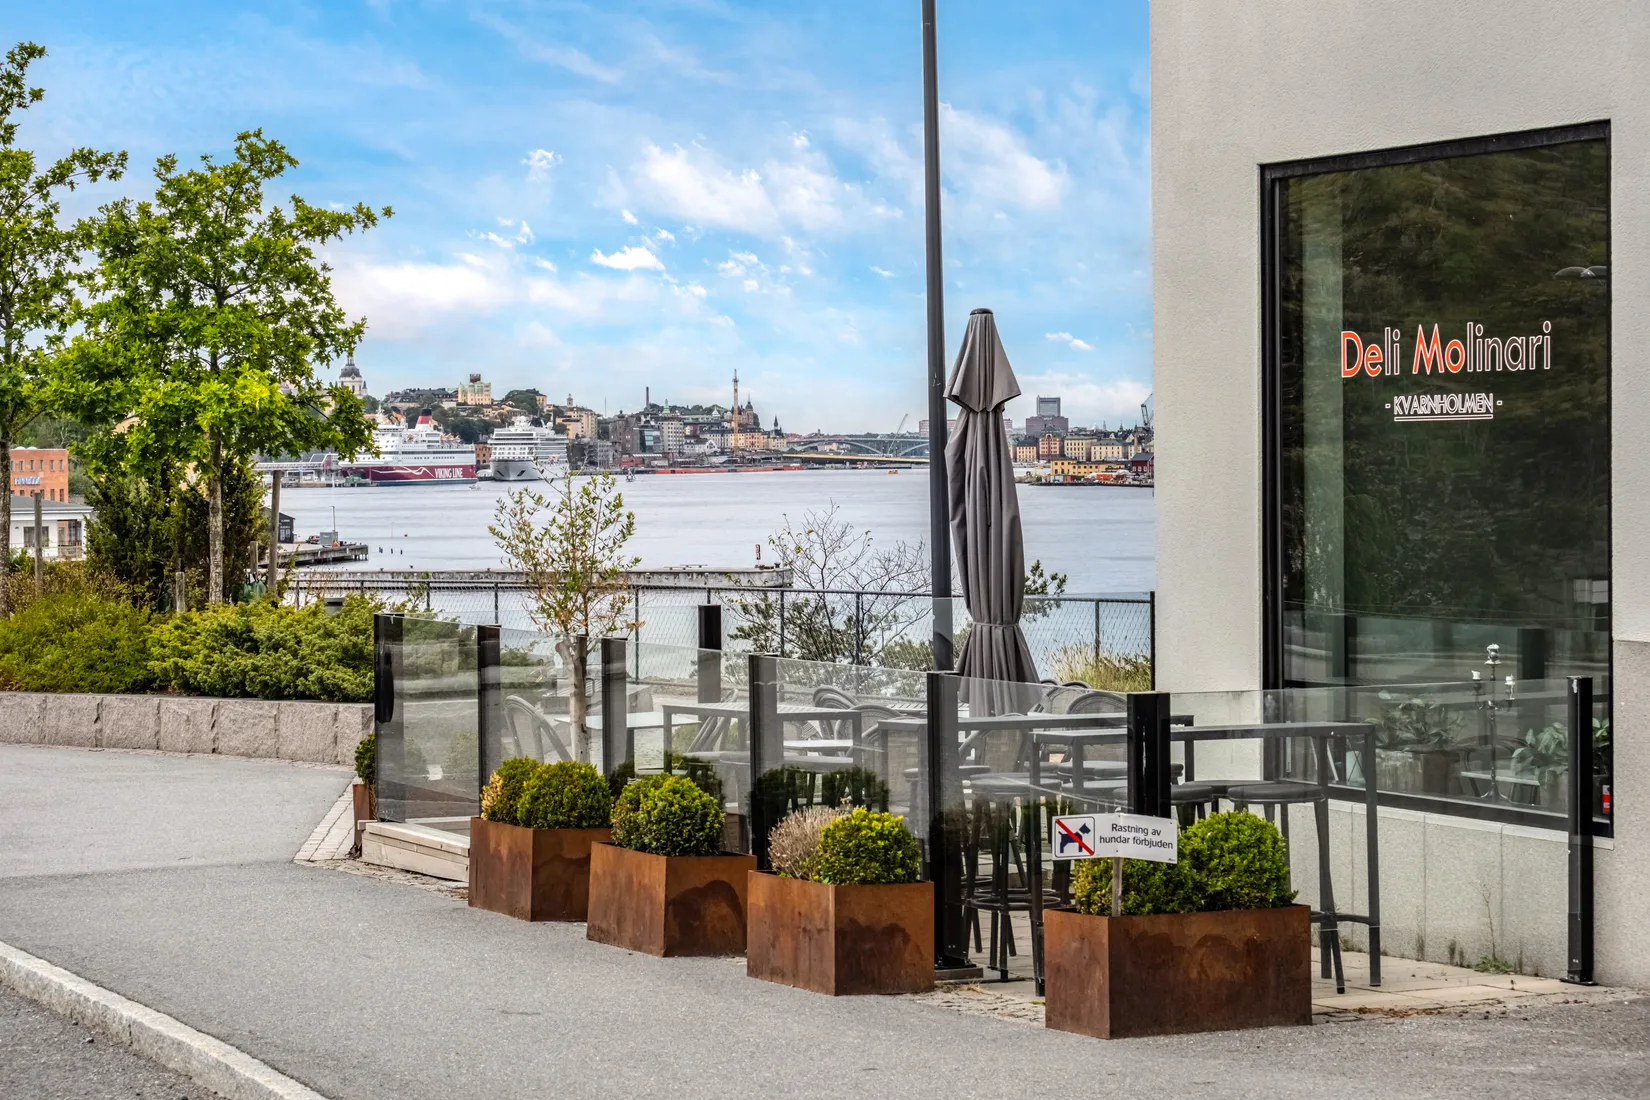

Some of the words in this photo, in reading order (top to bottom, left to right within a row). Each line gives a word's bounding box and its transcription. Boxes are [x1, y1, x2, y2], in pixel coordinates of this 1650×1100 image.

[1341, 327, 1400, 377] Deli
[1412, 320, 1551, 375] Molinari
[452, 468, 463, 478] LINE
[1112, 823, 1149, 837] Rastning
[1151, 828, 1162, 836] av
[1100, 835, 1130, 844] hundar
[1132, 836, 1173, 849] förbjuden
